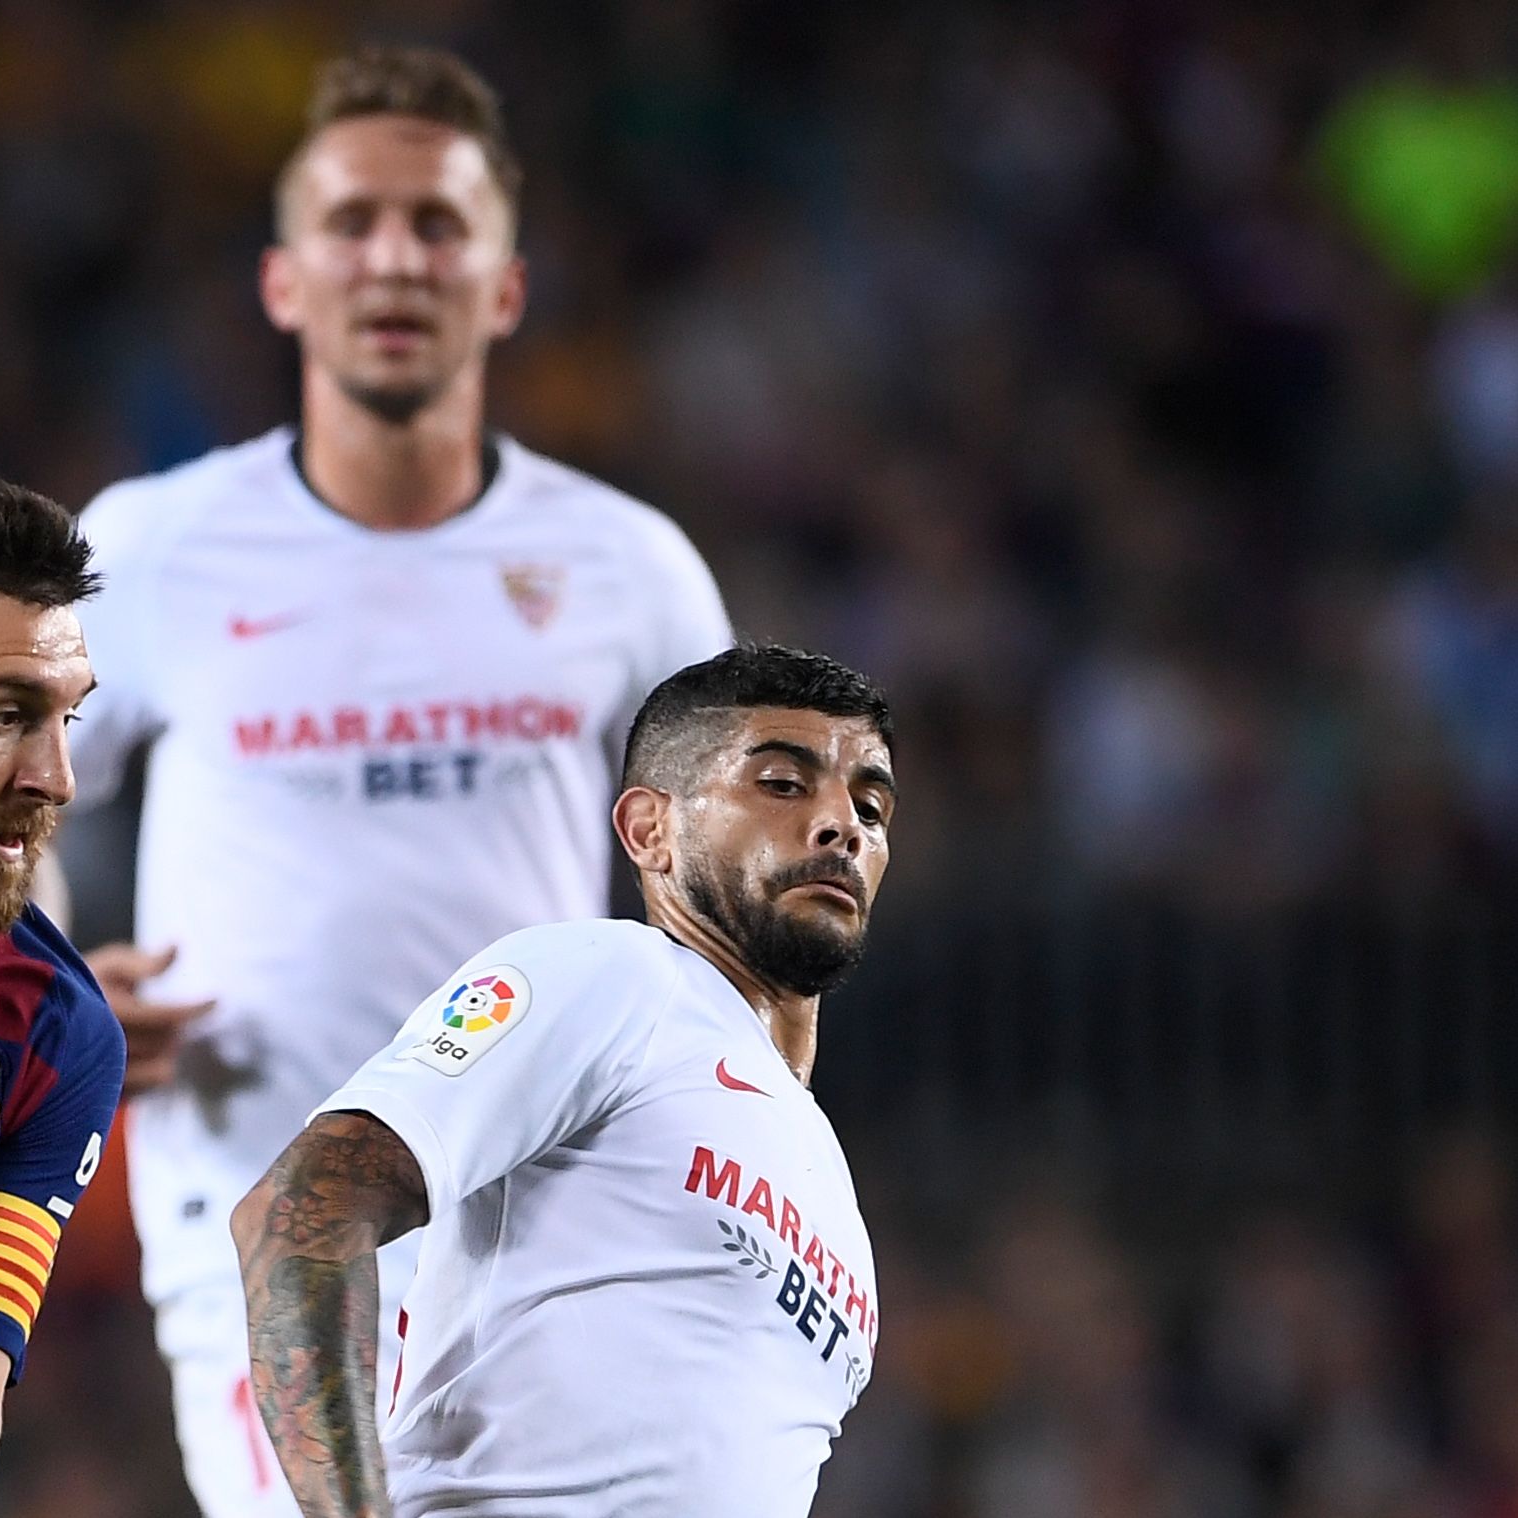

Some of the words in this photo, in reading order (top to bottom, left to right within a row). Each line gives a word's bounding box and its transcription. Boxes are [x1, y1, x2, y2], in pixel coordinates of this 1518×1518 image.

[234, 697, 580, 756] MARATHON
[363, 753, 479, 800] BET
[775, 1257, 850, 1363] BET
